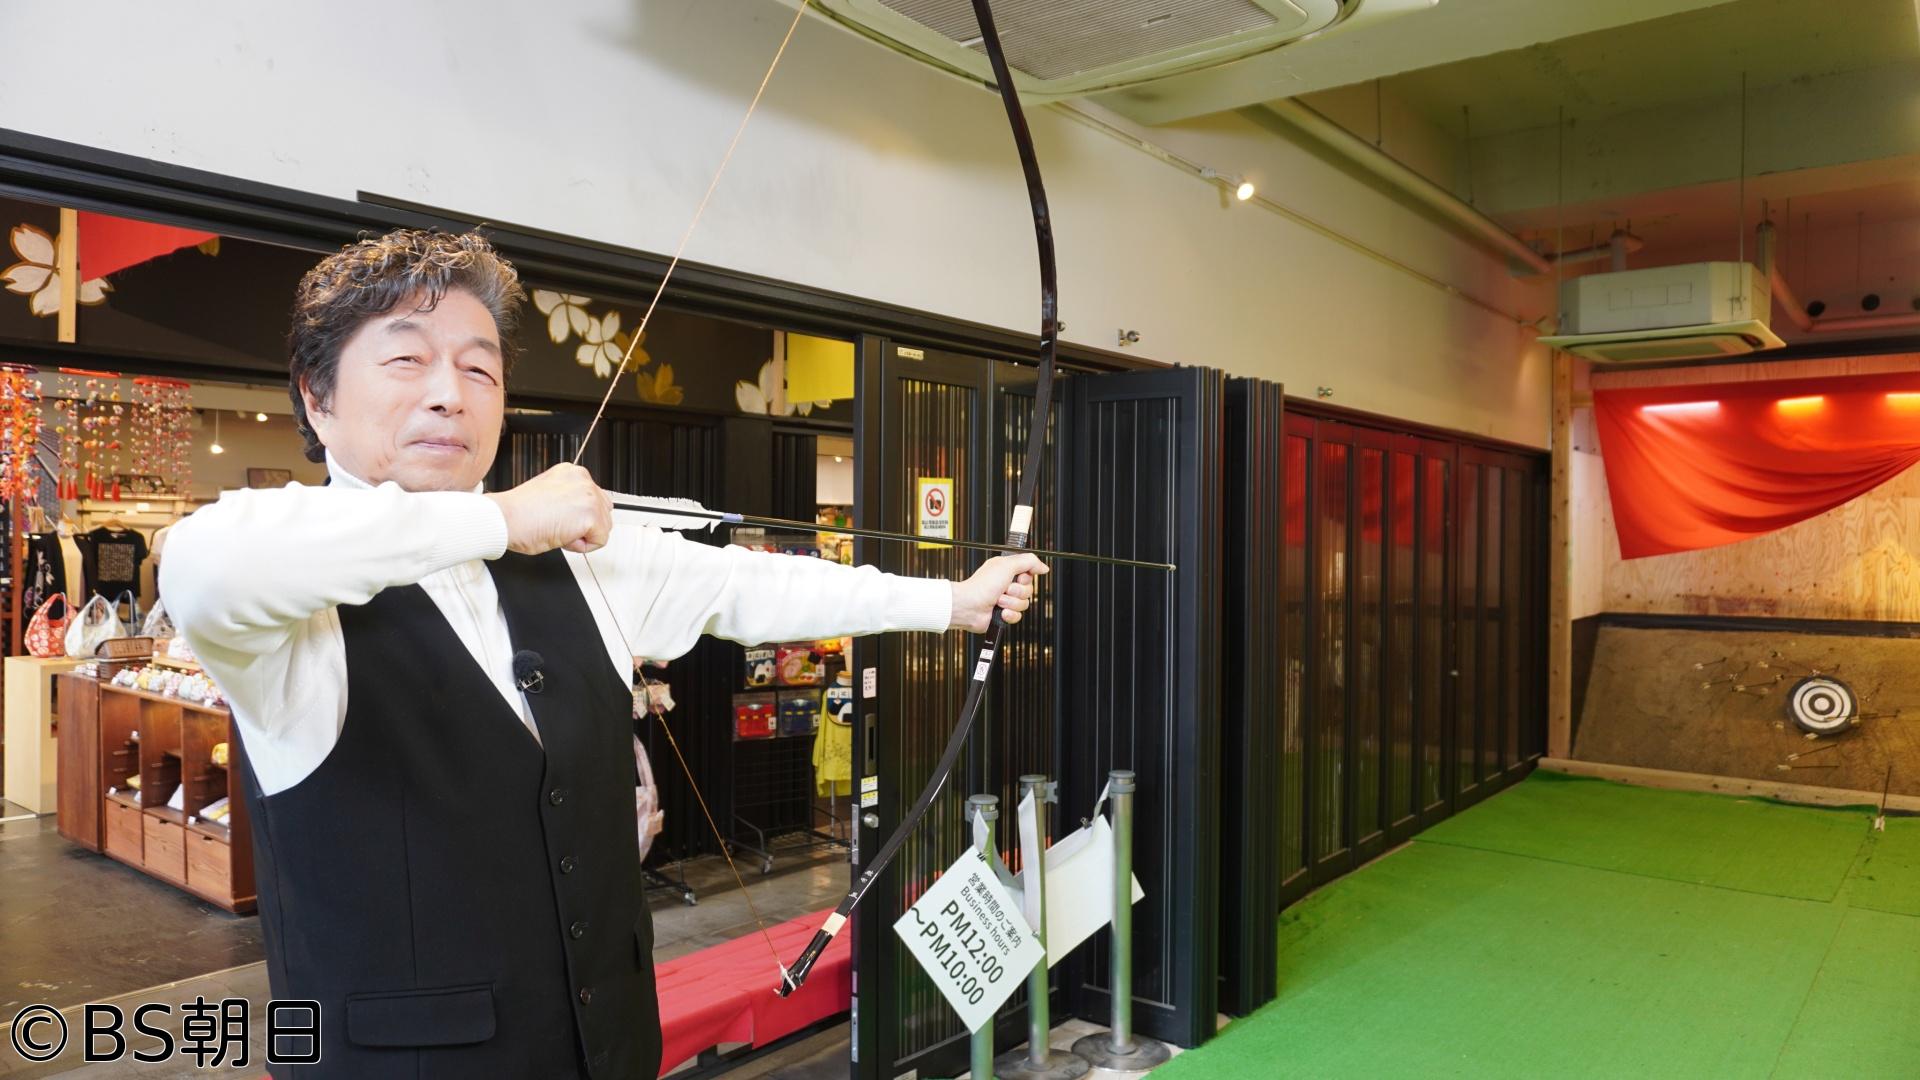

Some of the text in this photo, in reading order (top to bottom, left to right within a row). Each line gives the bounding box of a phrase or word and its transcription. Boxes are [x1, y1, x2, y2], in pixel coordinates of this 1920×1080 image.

[940, 899, 1004, 984] PM12:00
[960, 886, 1010, 956] Business hours
[968, 872, 1022, 949] 営業時間のご案内
